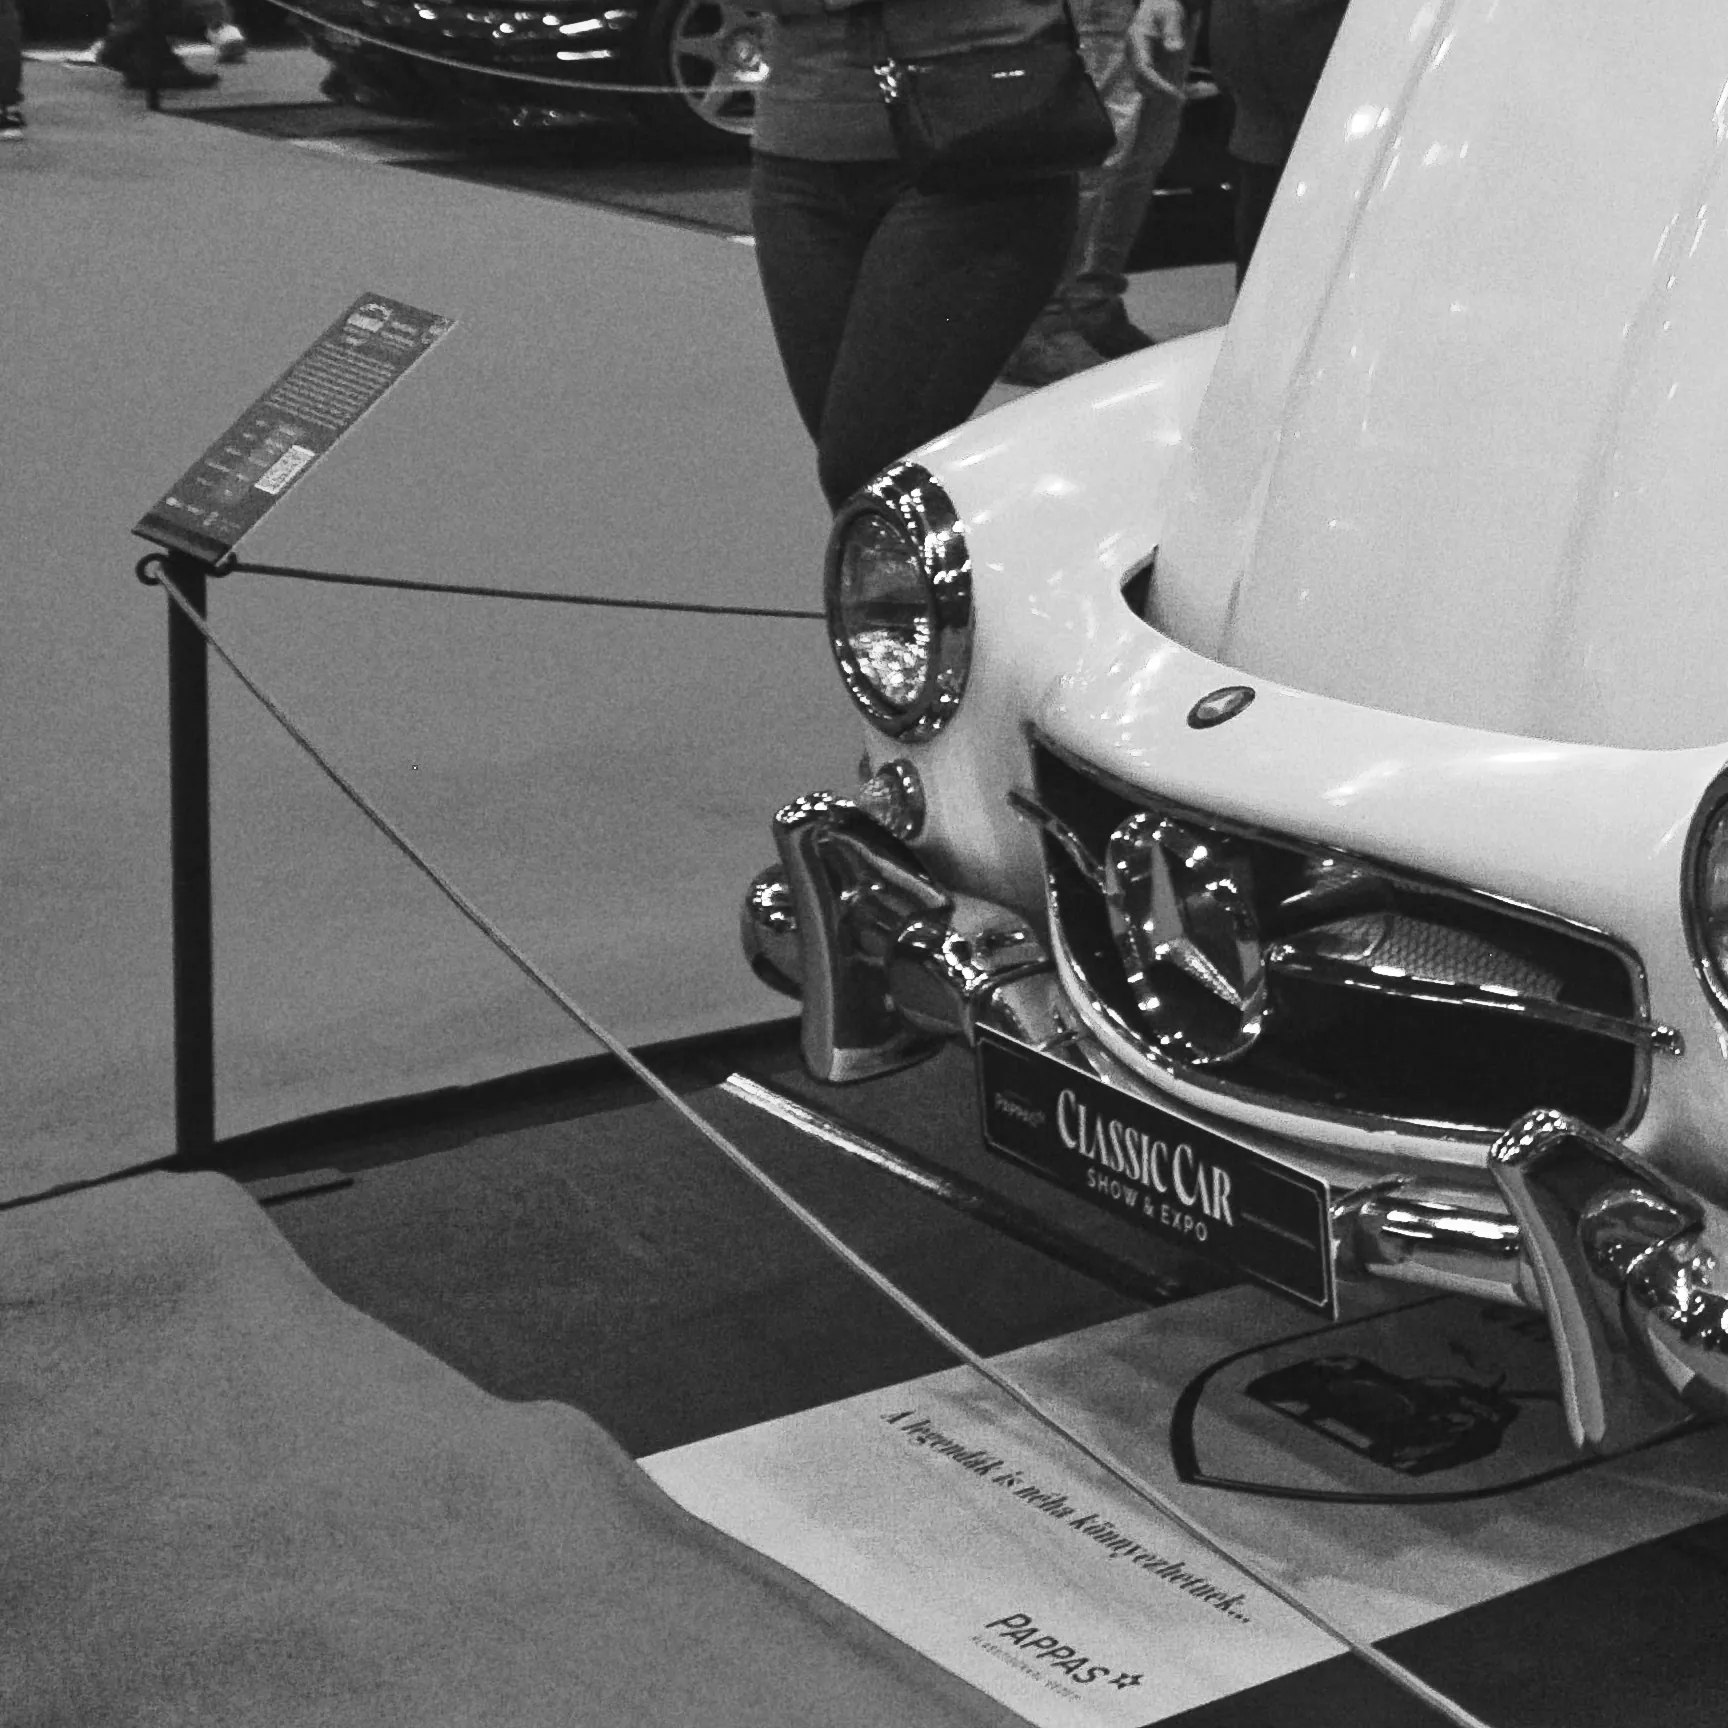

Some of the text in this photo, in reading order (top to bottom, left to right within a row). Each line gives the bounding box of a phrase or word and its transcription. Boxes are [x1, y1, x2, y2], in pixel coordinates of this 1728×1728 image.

[1087, 1168, 1208, 1242] SHOW & EXPO
[992, 1471, 1024, 1488] is
[1013, 1486, 1075, 1518] néha
[985, 1613, 1111, 1683] PAPPAS
